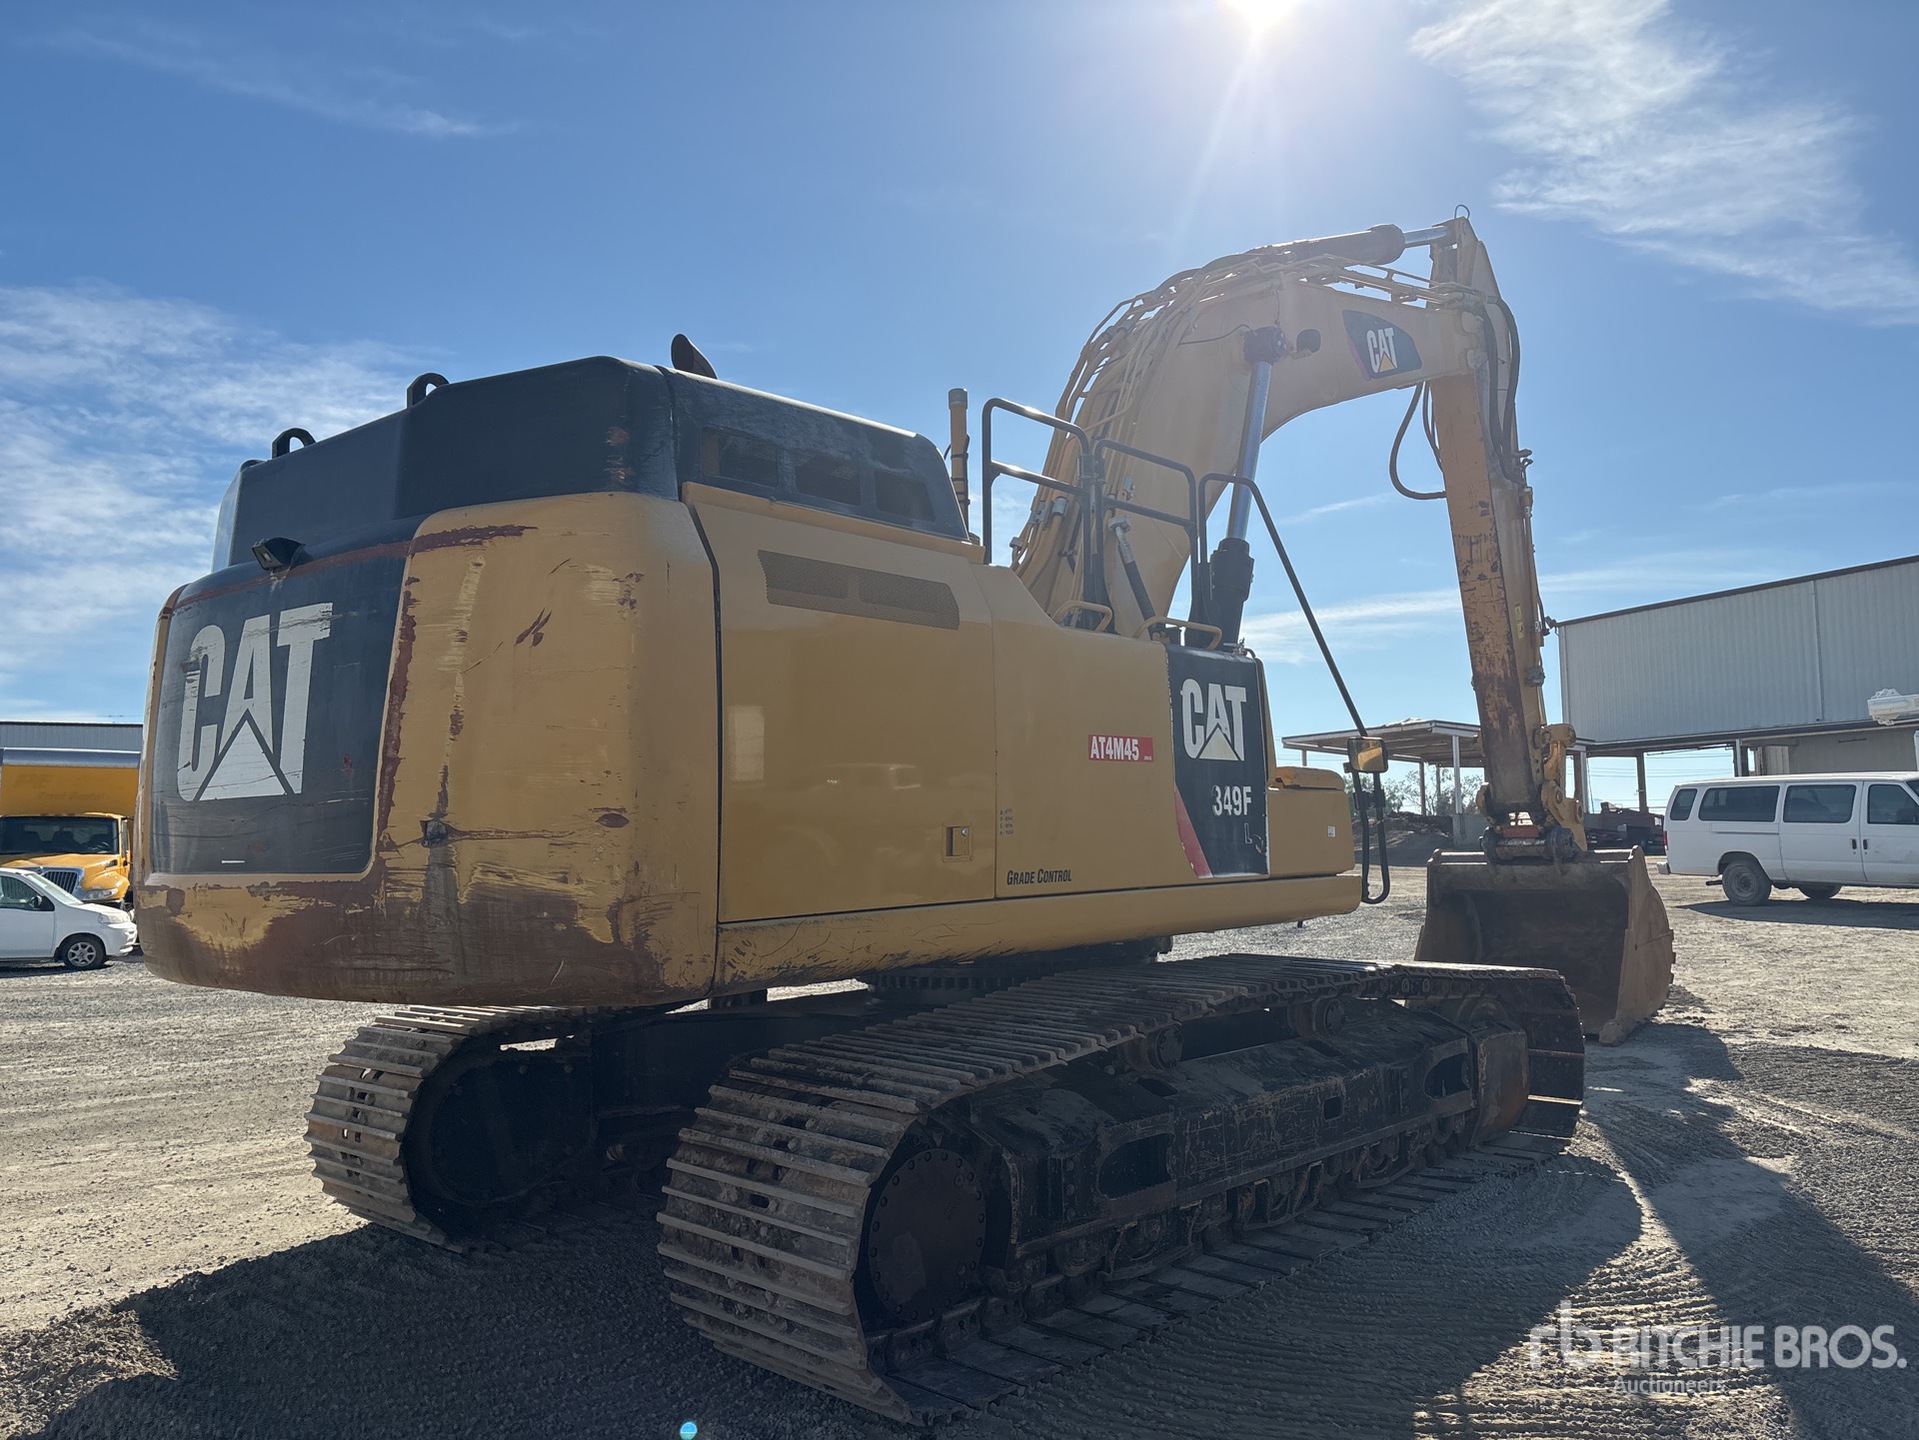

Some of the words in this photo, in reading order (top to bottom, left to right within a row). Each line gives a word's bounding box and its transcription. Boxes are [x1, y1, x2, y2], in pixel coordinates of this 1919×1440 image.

[1366, 327, 1398, 374] CAT
[177, 602, 333, 801] CAT
[1181, 678, 1247, 761] CAT
[1090, 736, 1139, 761] AT4M45
[1211, 785, 1252, 816] 349F
[1006, 870, 1036, 885] GRADE
[1037, 868, 1072, 883] CONTROL
